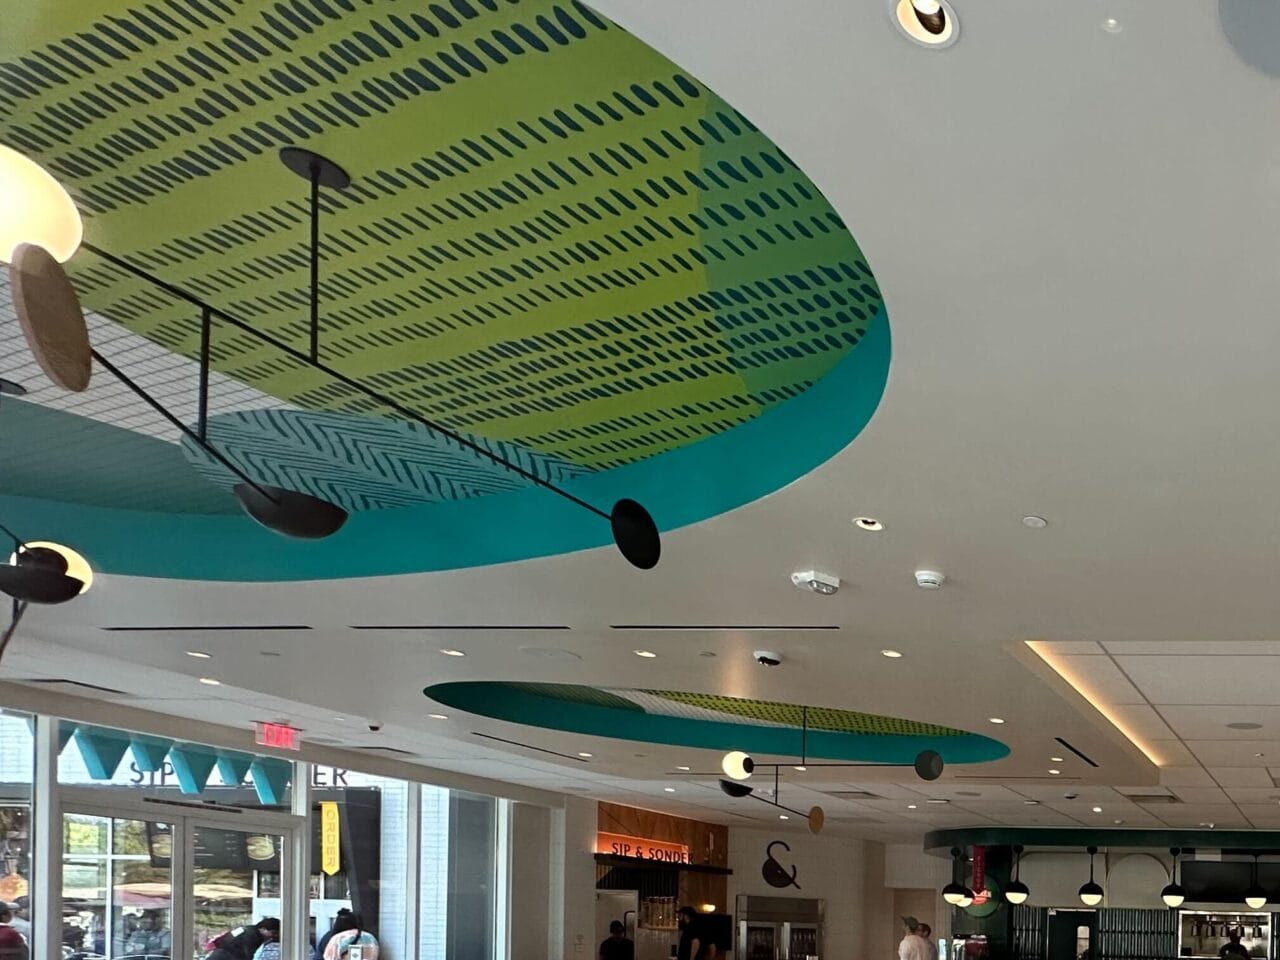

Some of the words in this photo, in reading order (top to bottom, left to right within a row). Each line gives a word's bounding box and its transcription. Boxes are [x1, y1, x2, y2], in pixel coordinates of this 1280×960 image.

[326, 808, 336, 867] ORDER
[612, 842, 631, 857] SIP
[635, 846, 643, 859] &
[648, 847, 694, 865] SONDER
